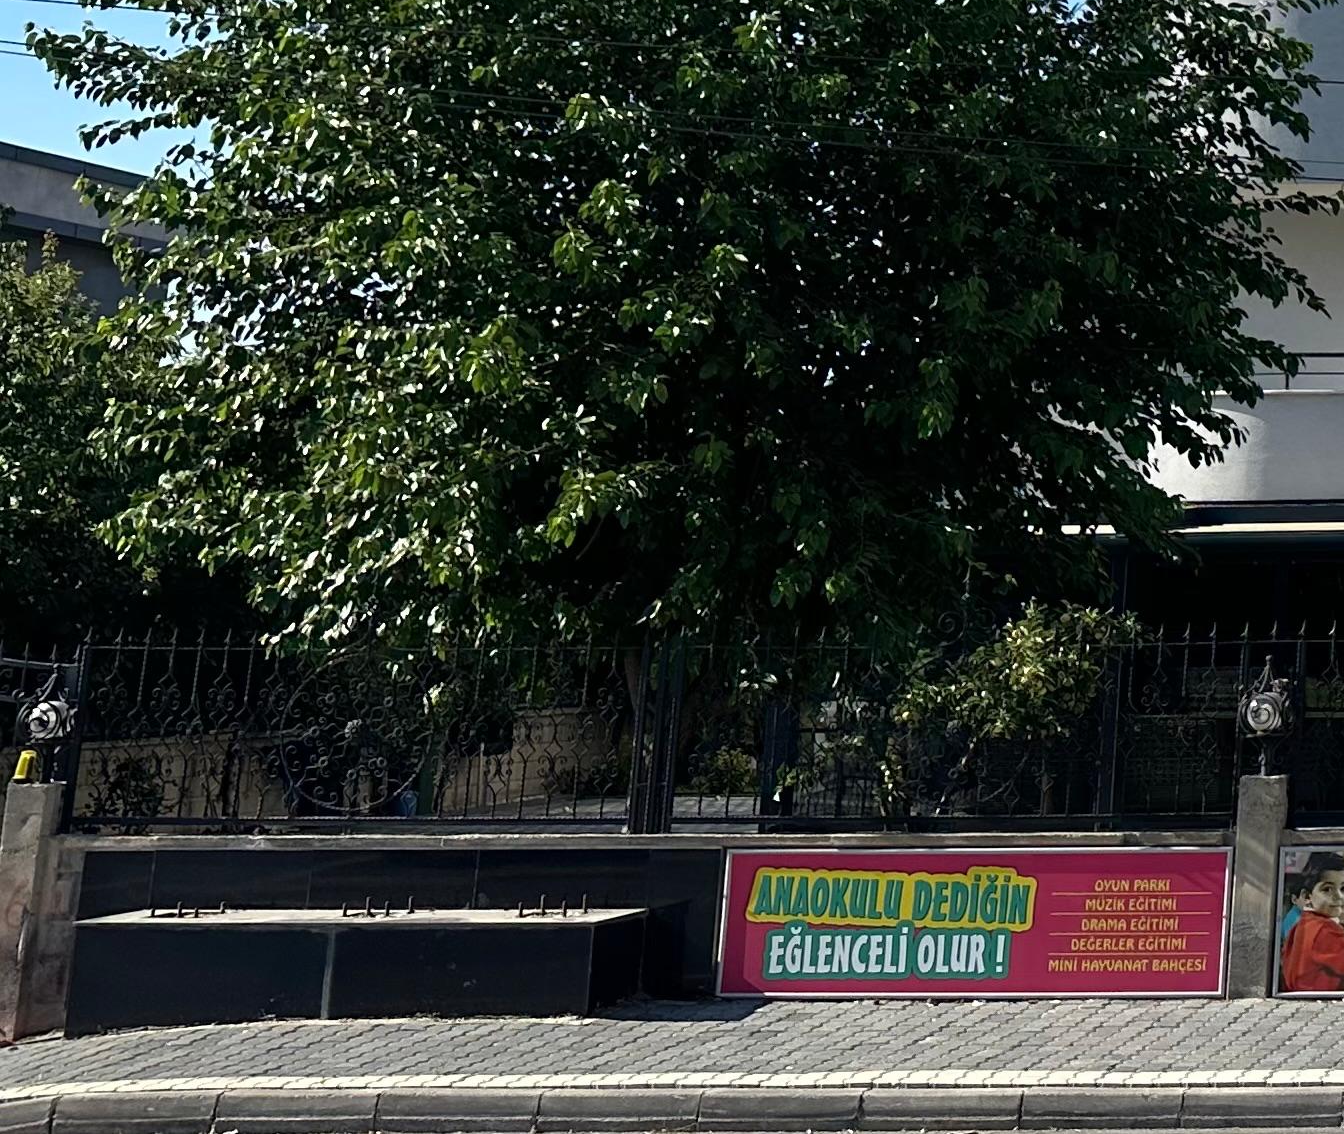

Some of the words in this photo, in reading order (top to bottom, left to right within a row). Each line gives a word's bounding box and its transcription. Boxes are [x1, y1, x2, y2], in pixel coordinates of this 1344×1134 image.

[1095, 879, 1129, 891] OYUN
[1134, 879, 1171, 891] PARKI
[754, 875, 904, 919] ANAOKULU
[914, 874, 1031, 924] DEDİĞİN
[1085, 896, 1125, 911] MÜZİK
[1128, 896, 1177, 911] EĞİTİMİ
[1081, 918, 1127, 931] DRAMA
[1130, 916, 1179, 931] EĞİTİMİ
[768, 926, 908, 974] EĞLENCELİ
[917, 934, 985, 975] OLUR
[996, 934, 1006, 973] !
[1071, 936, 1134, 951] DEĞERLER
[1138, 936, 1187, 950] EĞİTİMİ
[1048, 957, 1078, 972] MİNİ
[1081, 959, 1149, 972] HAYVANAT
[1152, 958, 1207, 974] BAHÇESİ
